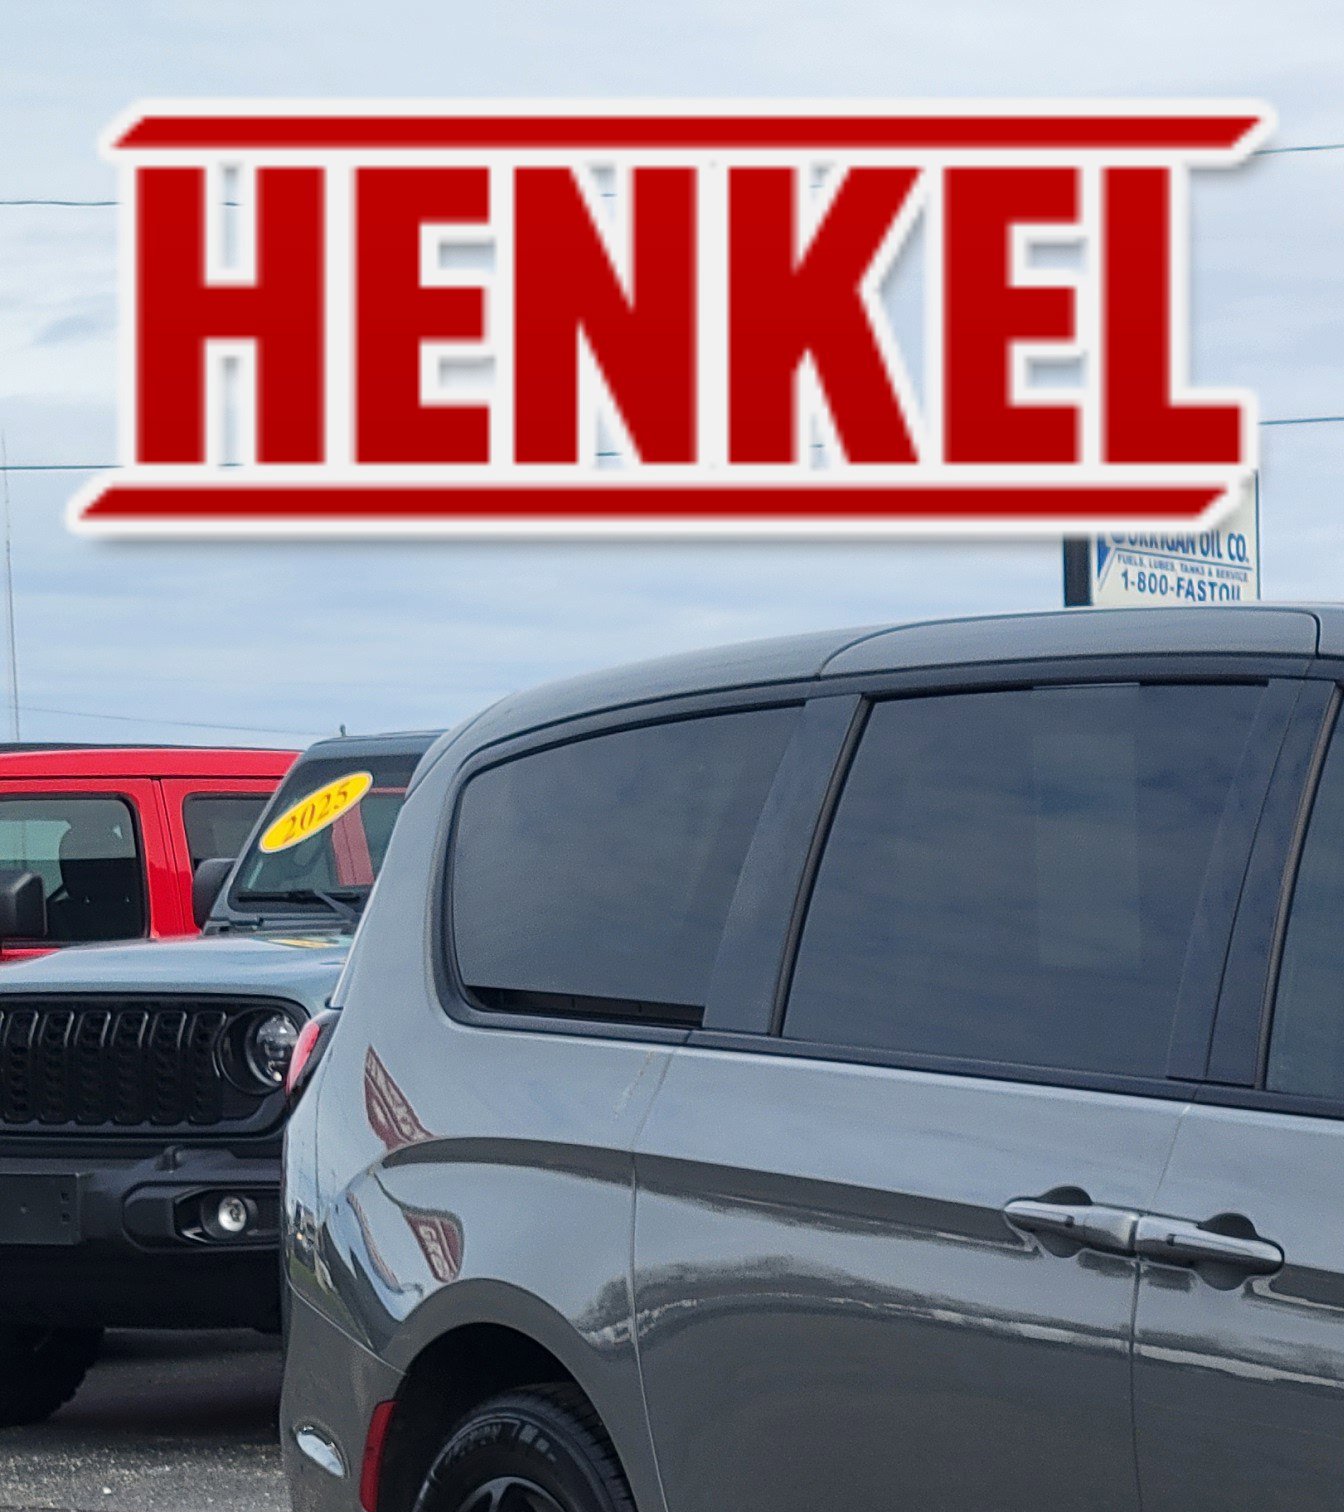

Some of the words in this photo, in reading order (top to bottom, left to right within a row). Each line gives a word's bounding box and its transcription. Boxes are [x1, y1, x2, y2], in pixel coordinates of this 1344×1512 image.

[1199, 529, 1222, 559] OIL
[1227, 532, 1249, 563] CO.
[282, 780, 351, 844] 2025
